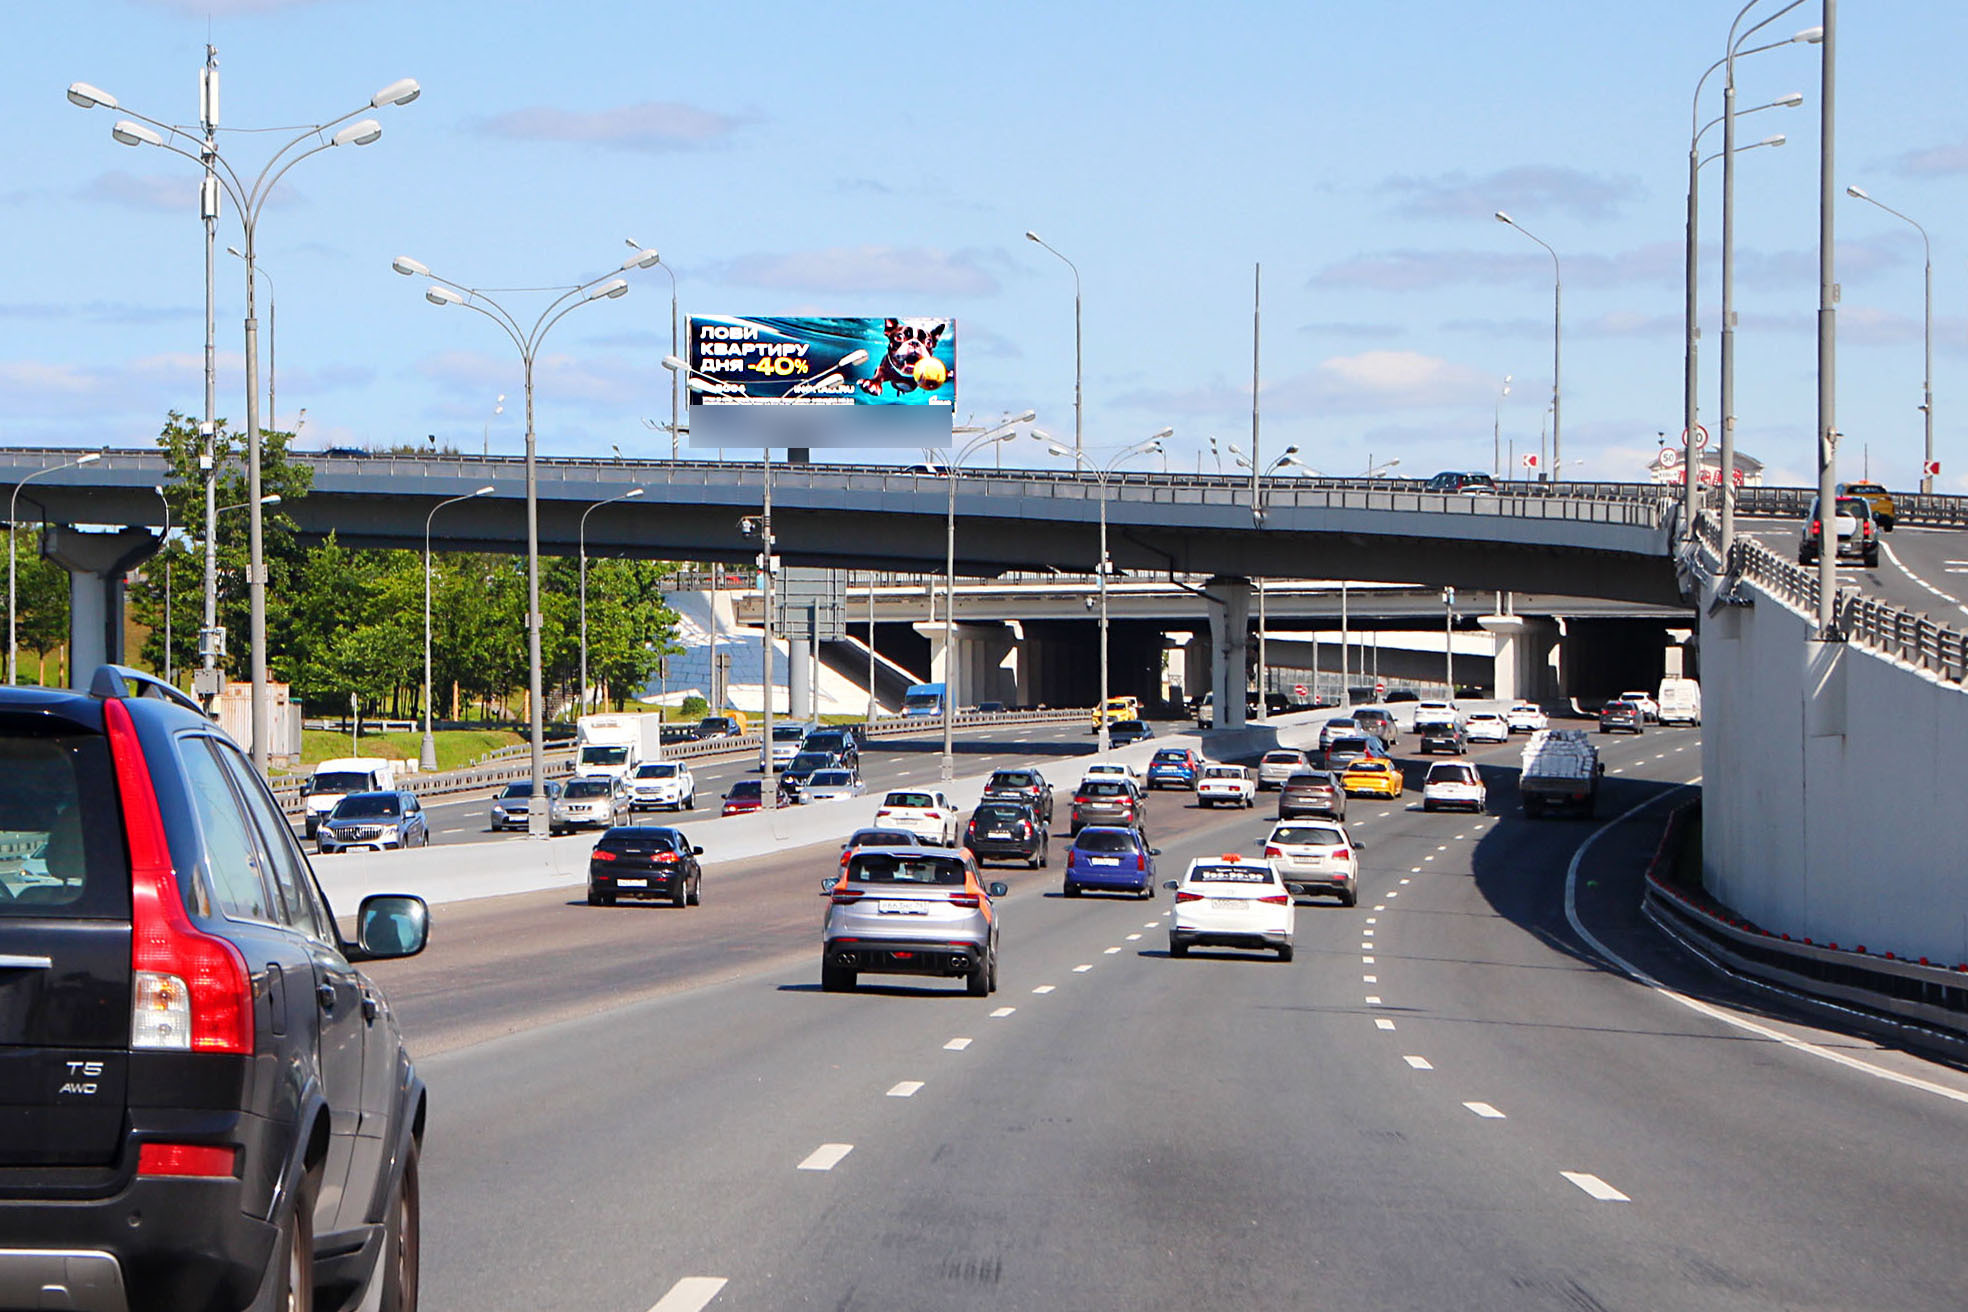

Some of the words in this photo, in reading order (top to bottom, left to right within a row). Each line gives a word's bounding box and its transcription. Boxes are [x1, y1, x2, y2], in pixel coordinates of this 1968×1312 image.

[700, 326, 758, 340] ЛОВИ
[700, 342, 810, 356] КВАРТИРУ
[700, 358, 744, 373] ДНЯ
[747, 356, 809, 376] -40%
[1663, 453, 1674, 463] 50
[66, 1061, 104, 1076] T5
[59, 1083, 97, 1094] AWD
